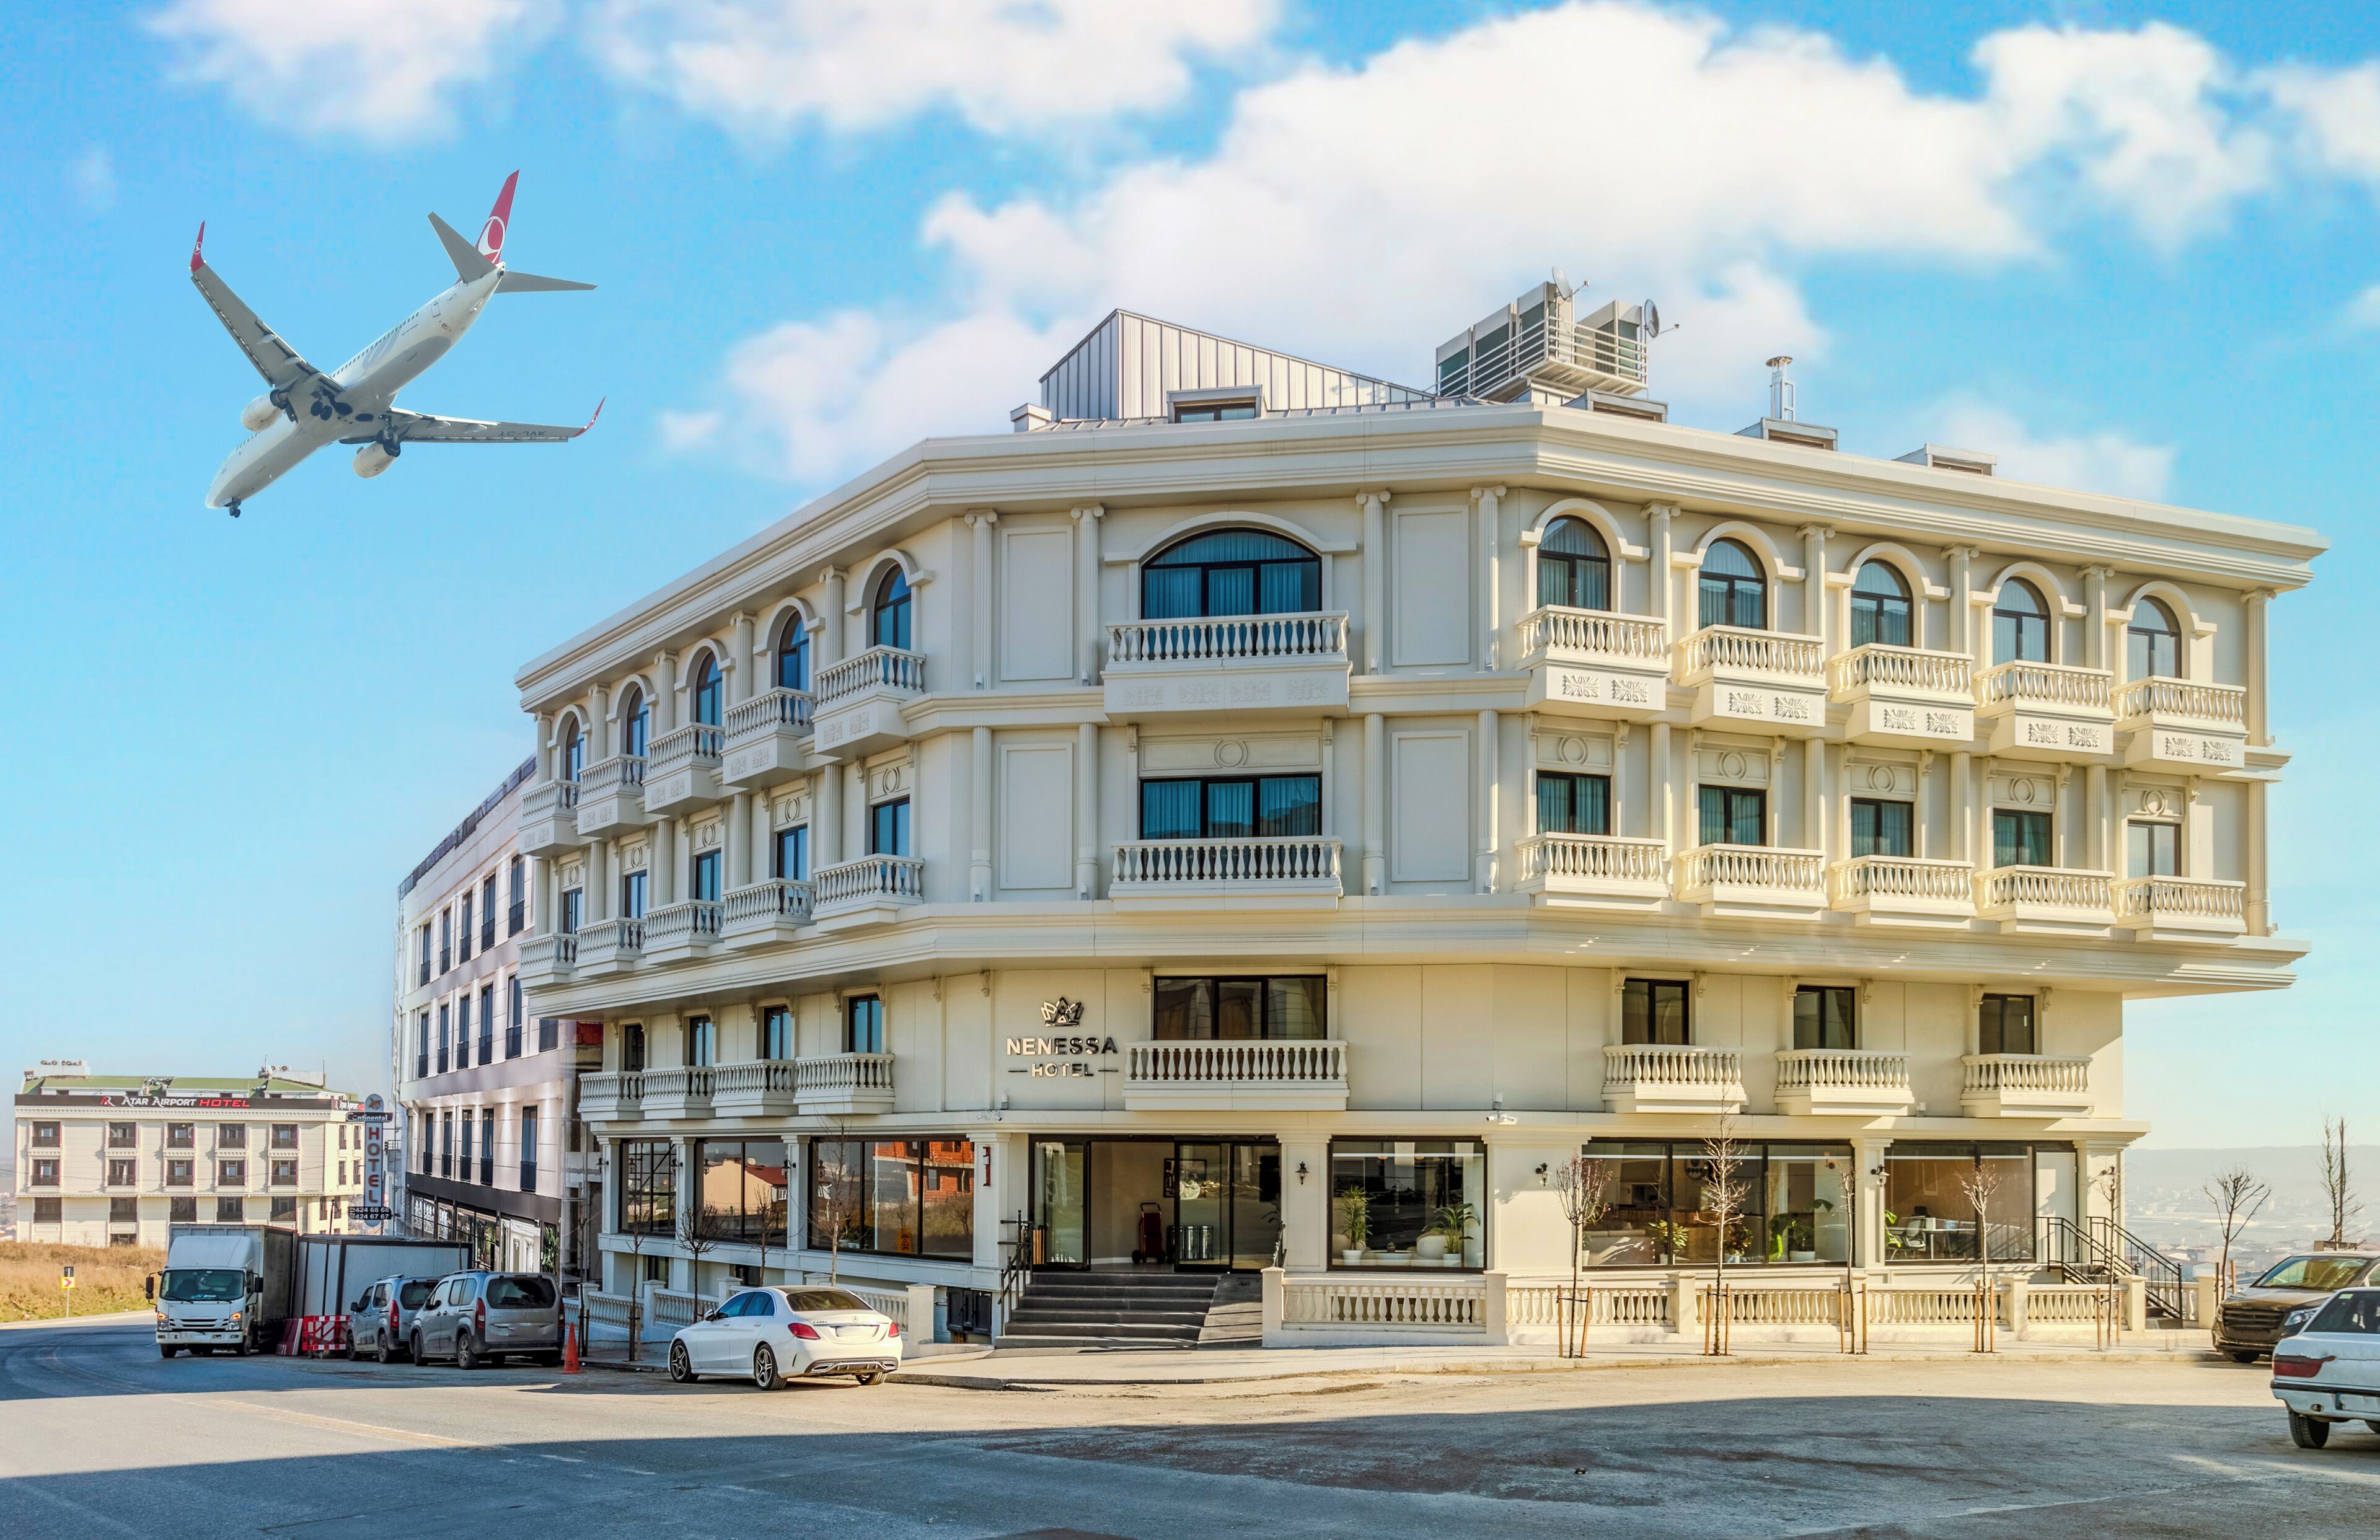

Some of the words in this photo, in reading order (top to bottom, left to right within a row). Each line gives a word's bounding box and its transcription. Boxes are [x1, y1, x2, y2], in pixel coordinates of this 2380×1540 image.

[1007, 1037, 1117, 1055] NENESSA
[1031, 1063, 1094, 1077] HOTEL
[121, 1096, 149, 1107] ATAR
[151, 1096, 197, 1107] AIRPORT
[347, 1112, 387, 1121] Continental
[368, 1127, 380, 1203] HOTEL
